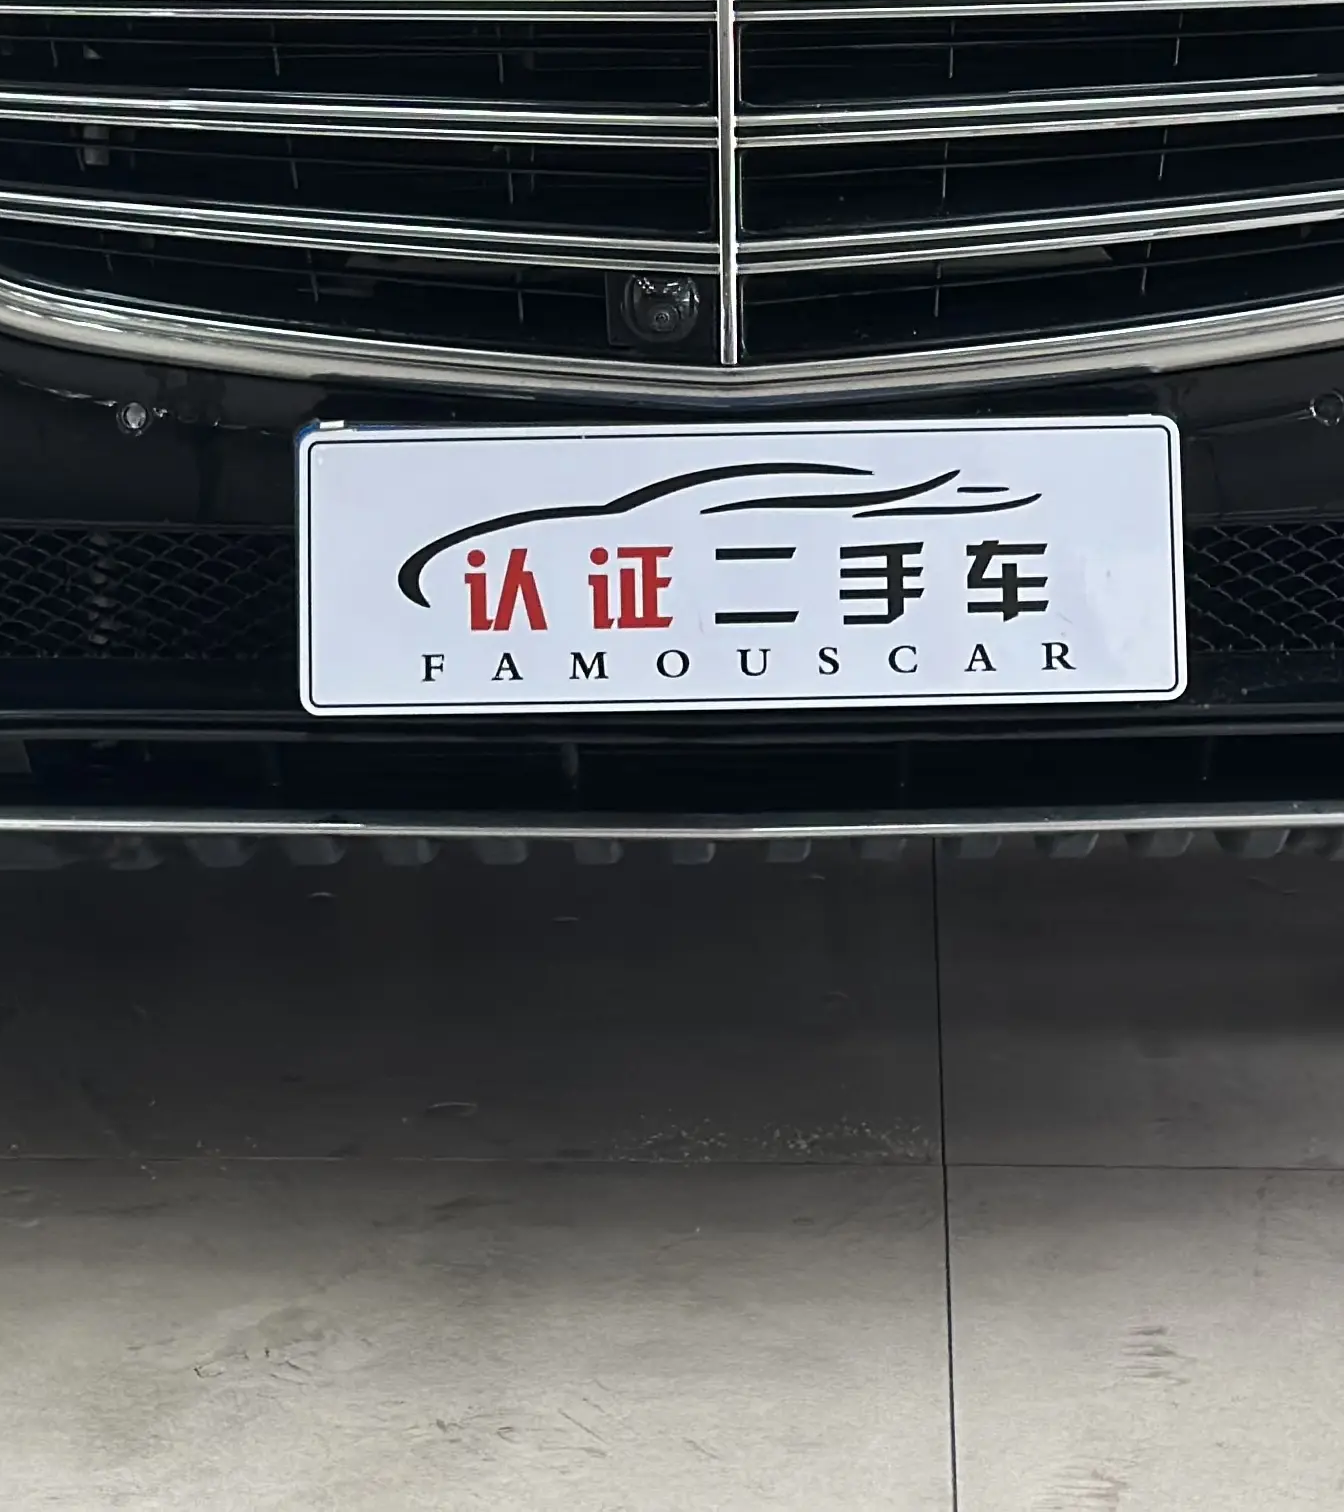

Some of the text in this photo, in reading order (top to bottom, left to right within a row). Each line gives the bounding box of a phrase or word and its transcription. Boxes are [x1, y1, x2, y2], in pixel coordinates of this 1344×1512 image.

[464, 539, 1050, 632] 认证二手车
[421, 641, 1077, 682] FAMOUSCAR
